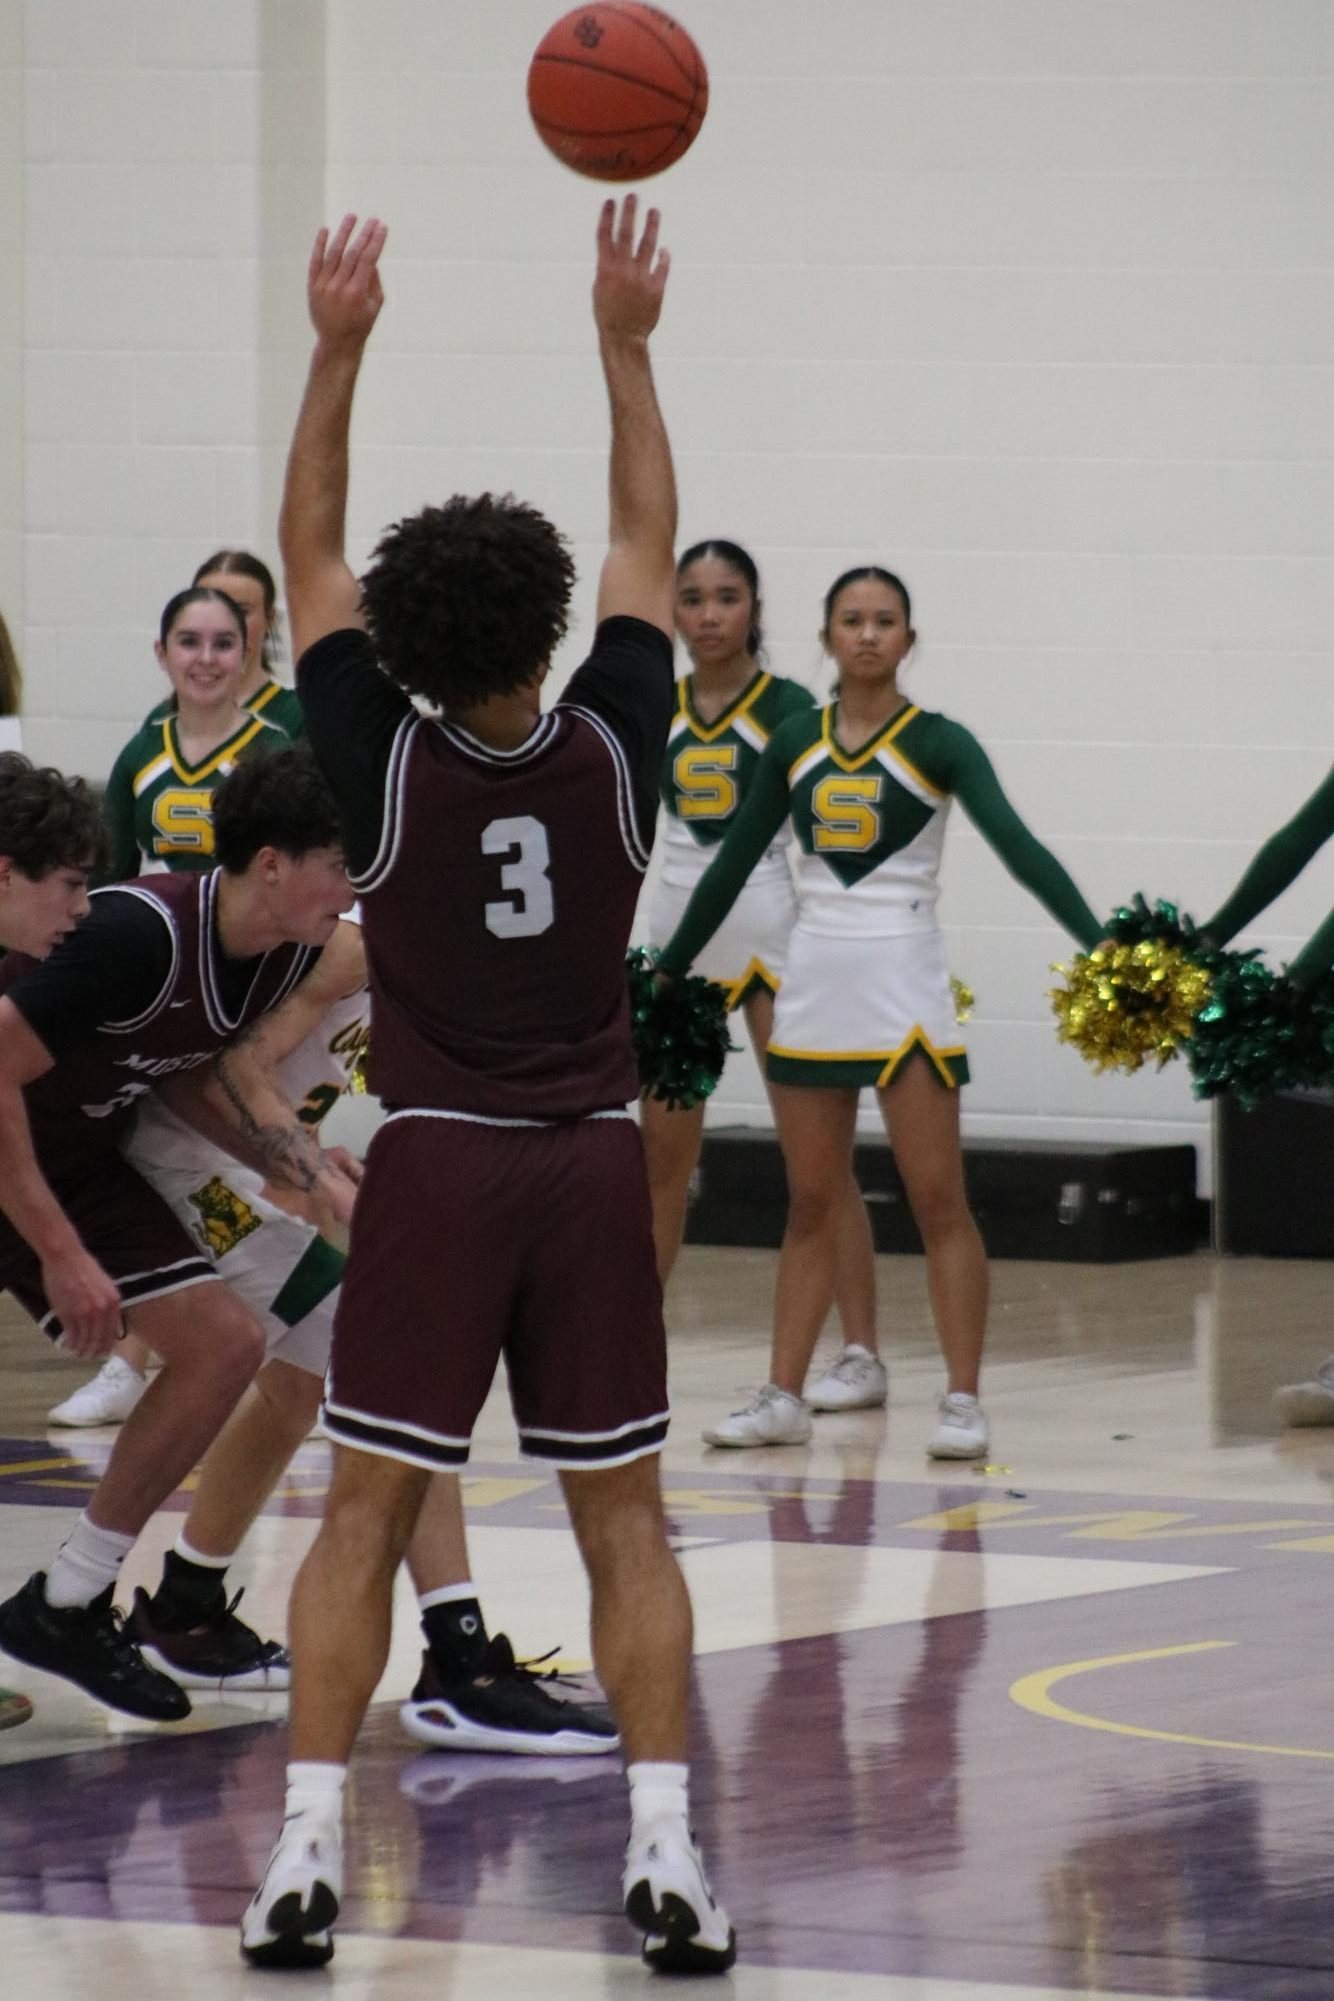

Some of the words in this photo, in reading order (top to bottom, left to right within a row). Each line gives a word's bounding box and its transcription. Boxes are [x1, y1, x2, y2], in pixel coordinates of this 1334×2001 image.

[673, 744, 737, 820] S
[811, 774, 882, 852] S
[151, 787, 217, 857] S
[480, 814, 555, 940] 3
